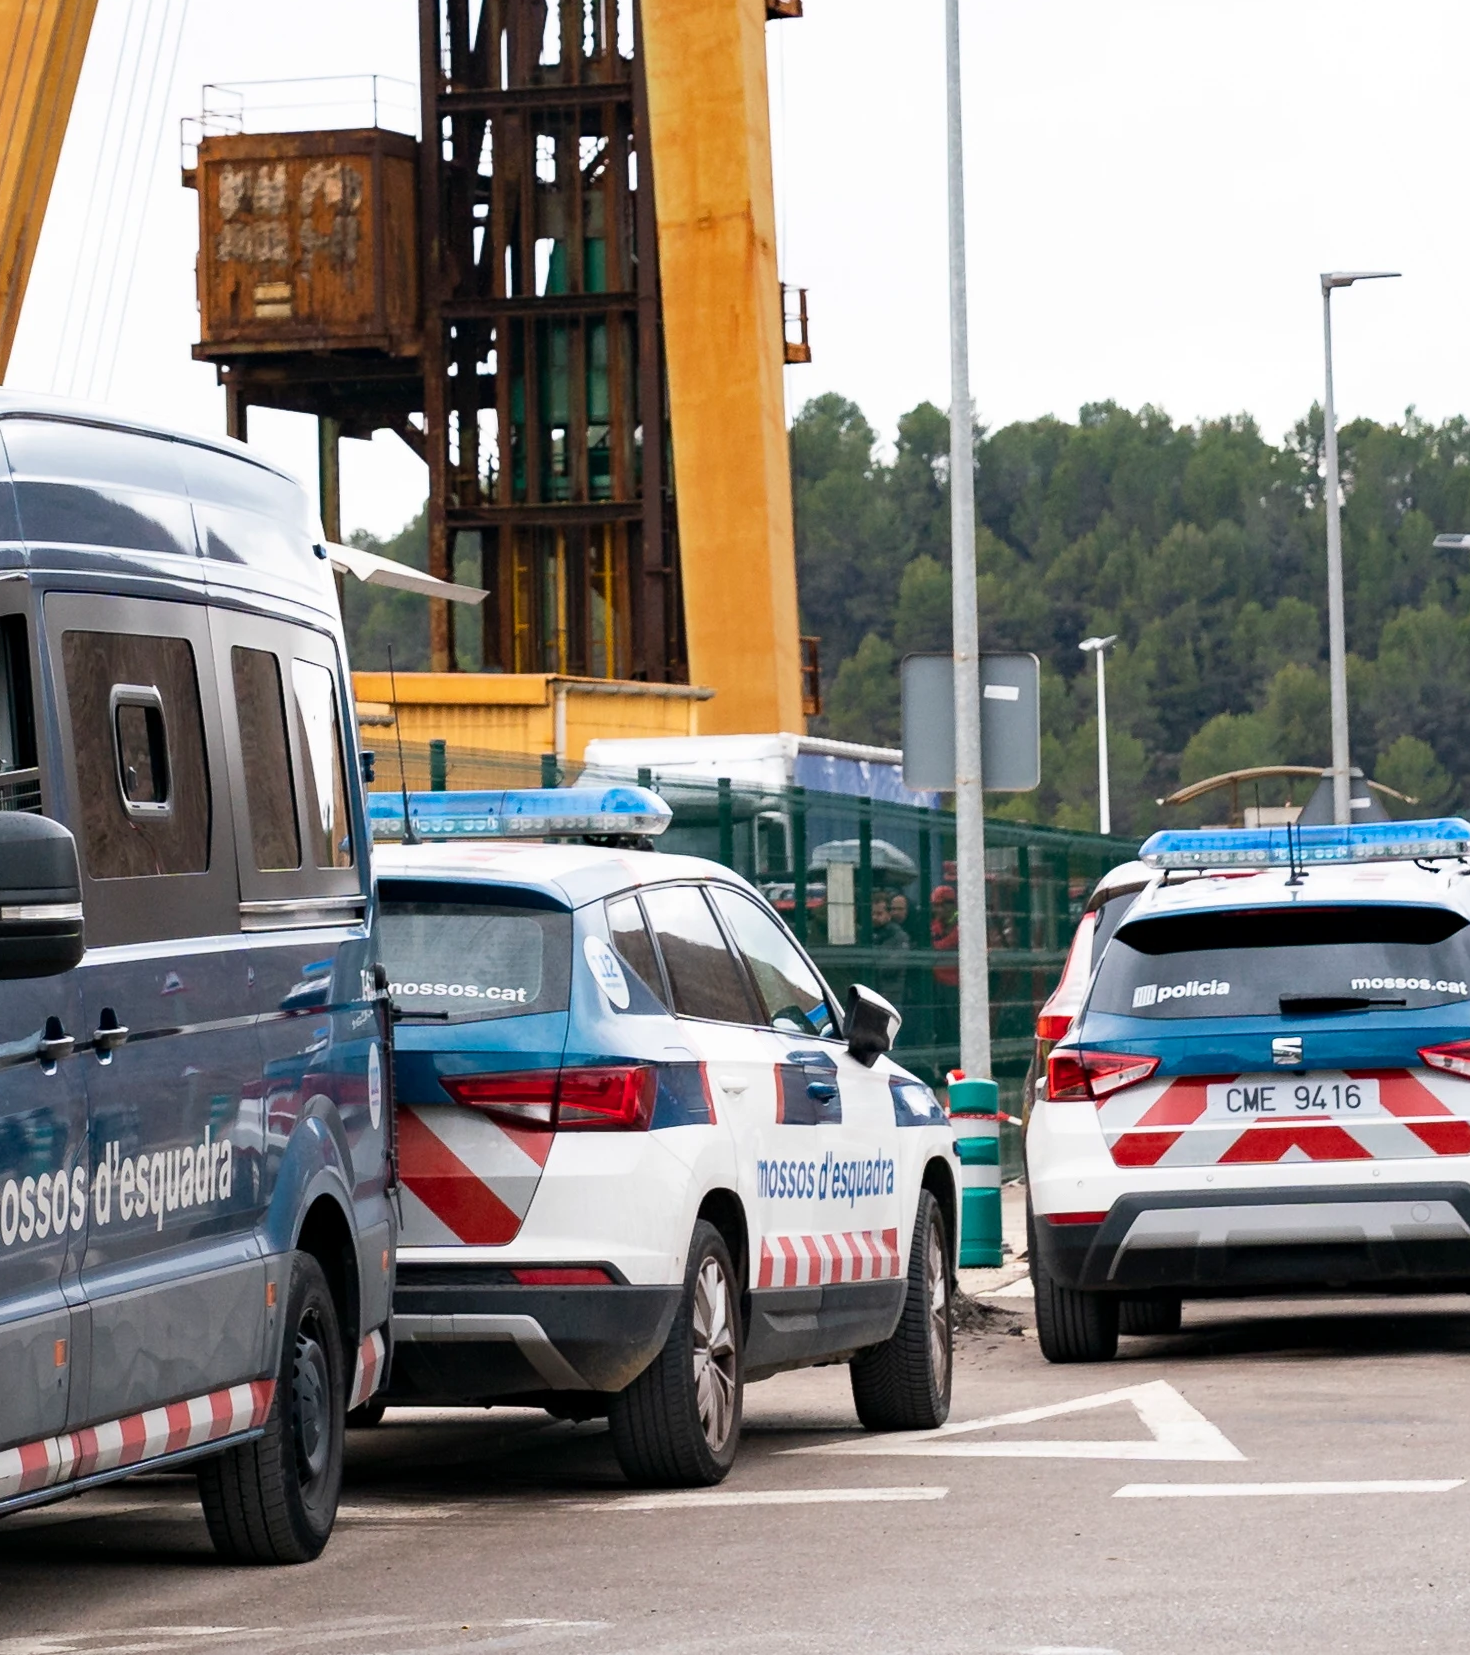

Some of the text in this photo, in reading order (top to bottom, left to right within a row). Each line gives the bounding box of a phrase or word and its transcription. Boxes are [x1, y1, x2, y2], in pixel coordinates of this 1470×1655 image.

[1157, 979, 1230, 1003] policia
[1351, 978, 1468, 995] mossos.cat
[1226, 1084, 1362, 1113] CME 9416
[94, 1124, 233, 1232] d'esquadra
[757, 1147, 894, 1209] mossos d'esquadra
